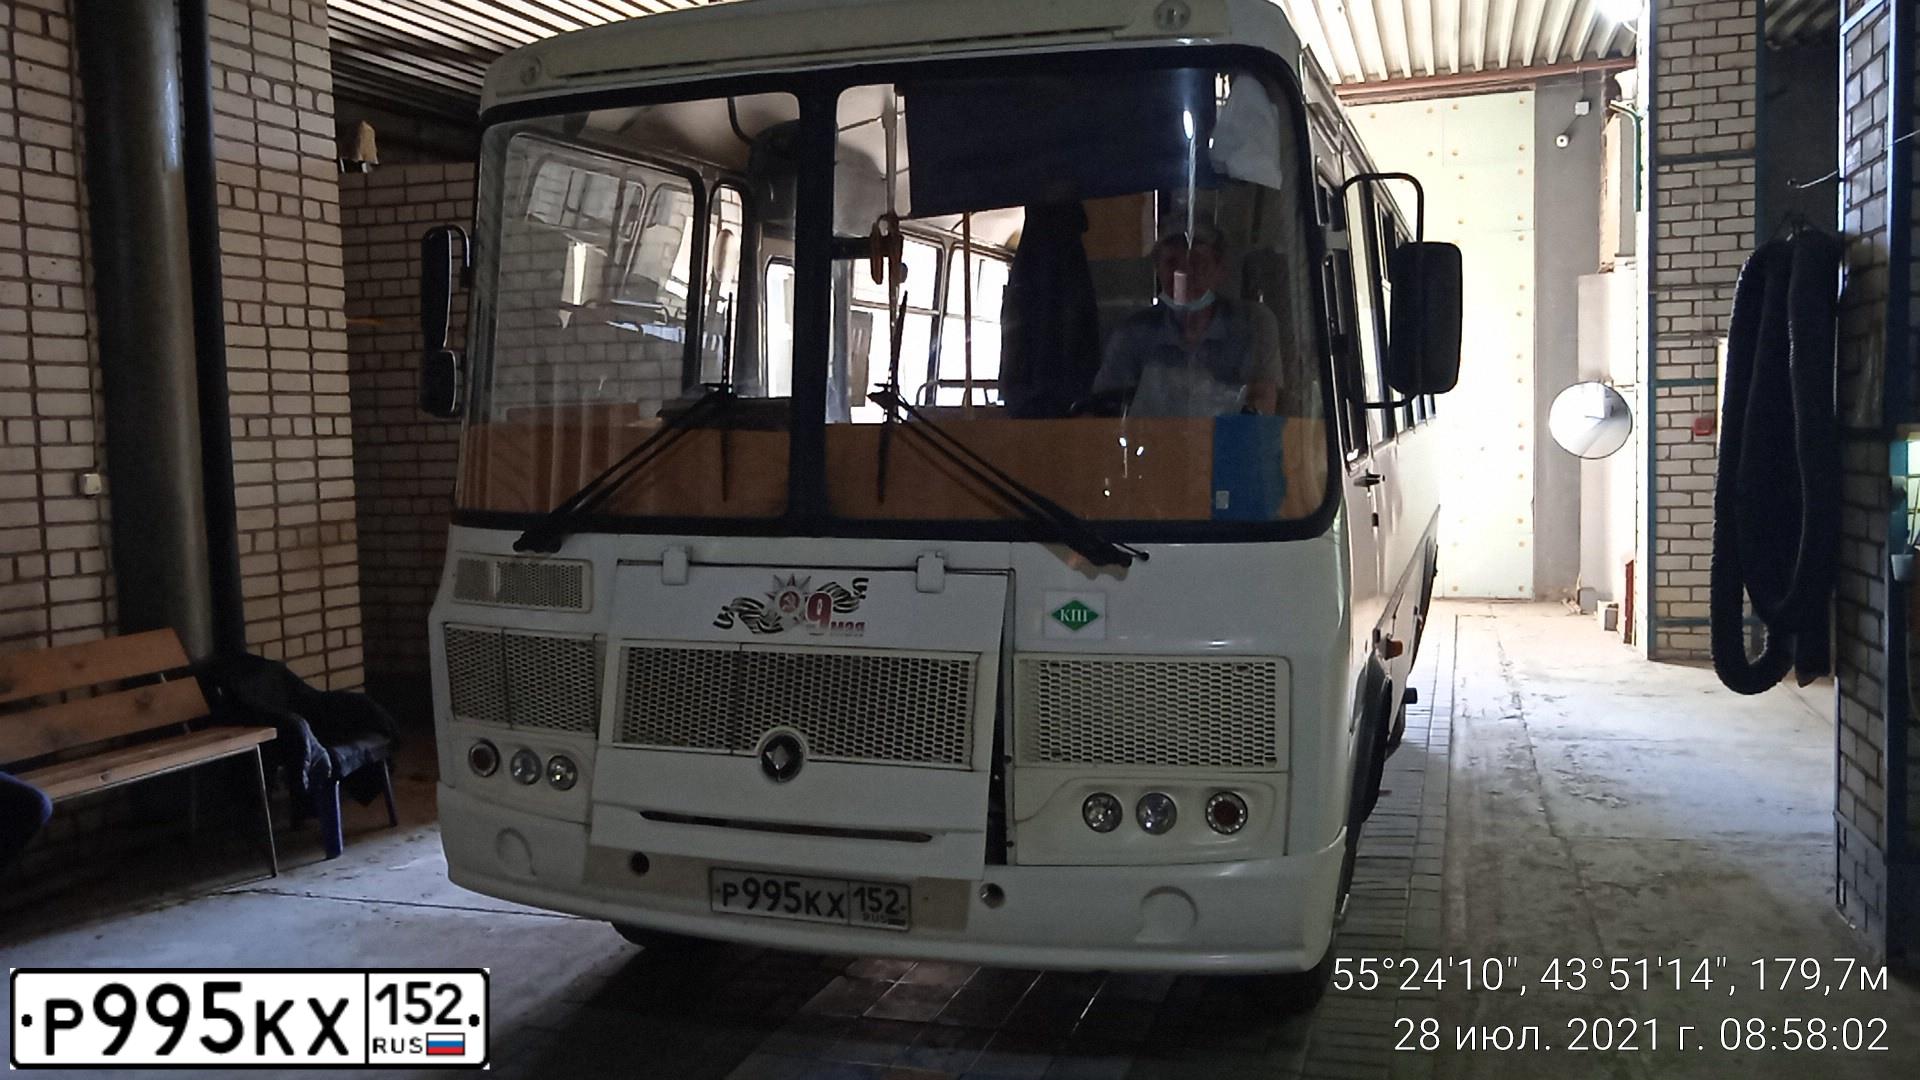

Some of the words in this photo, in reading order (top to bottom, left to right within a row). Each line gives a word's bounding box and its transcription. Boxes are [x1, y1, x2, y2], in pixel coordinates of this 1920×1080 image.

[805, 591, 833, 635] 9
[722, 876, 845, 919] Р995КХ
[853, 886, 900, 915] 152
